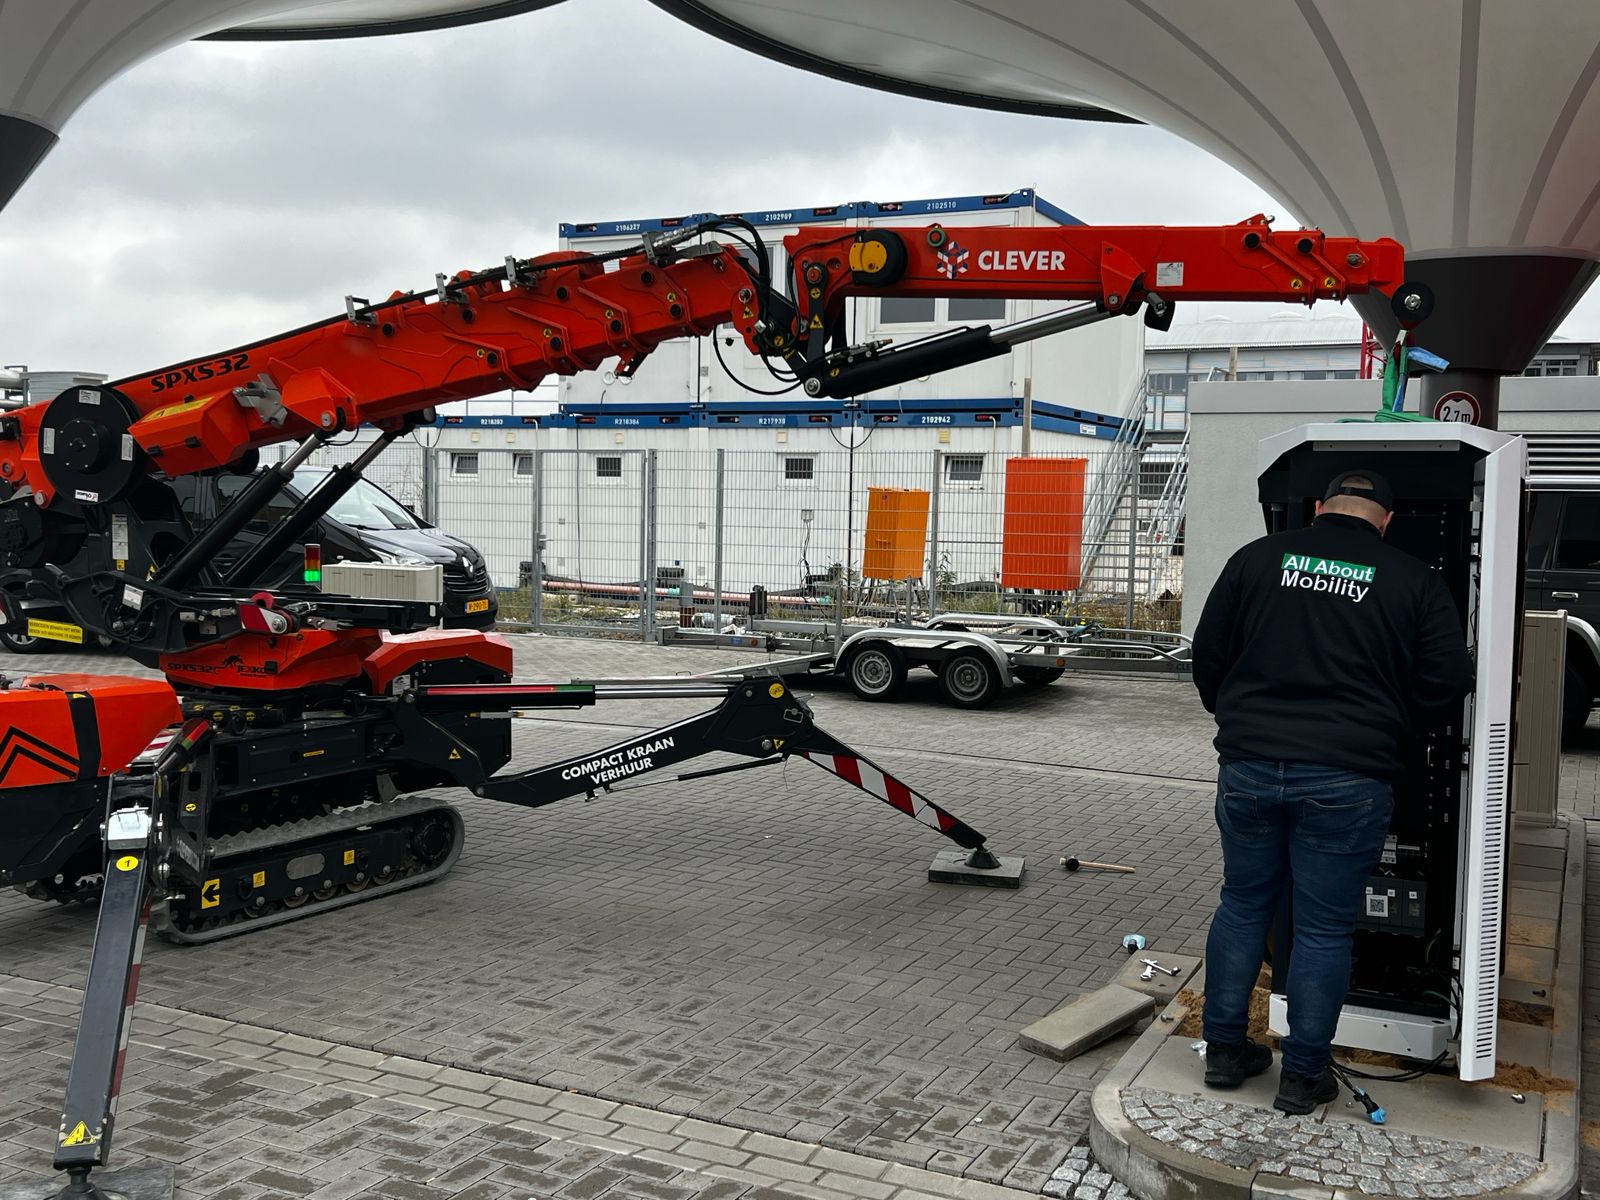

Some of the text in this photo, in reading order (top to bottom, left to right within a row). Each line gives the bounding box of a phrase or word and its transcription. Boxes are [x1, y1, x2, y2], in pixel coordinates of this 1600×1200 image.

[926, 201, 957, 210] 2102510
[977, 250, 1066, 271] CLEVER
[921, 415, 951, 424] 2102942
[1283, 555, 1373, 582] All About
[1280, 569, 1370, 603] Mobility
[561, 736, 675, 780] COMPACT KRAAN
[590, 757, 654, 785] VERHUUR
